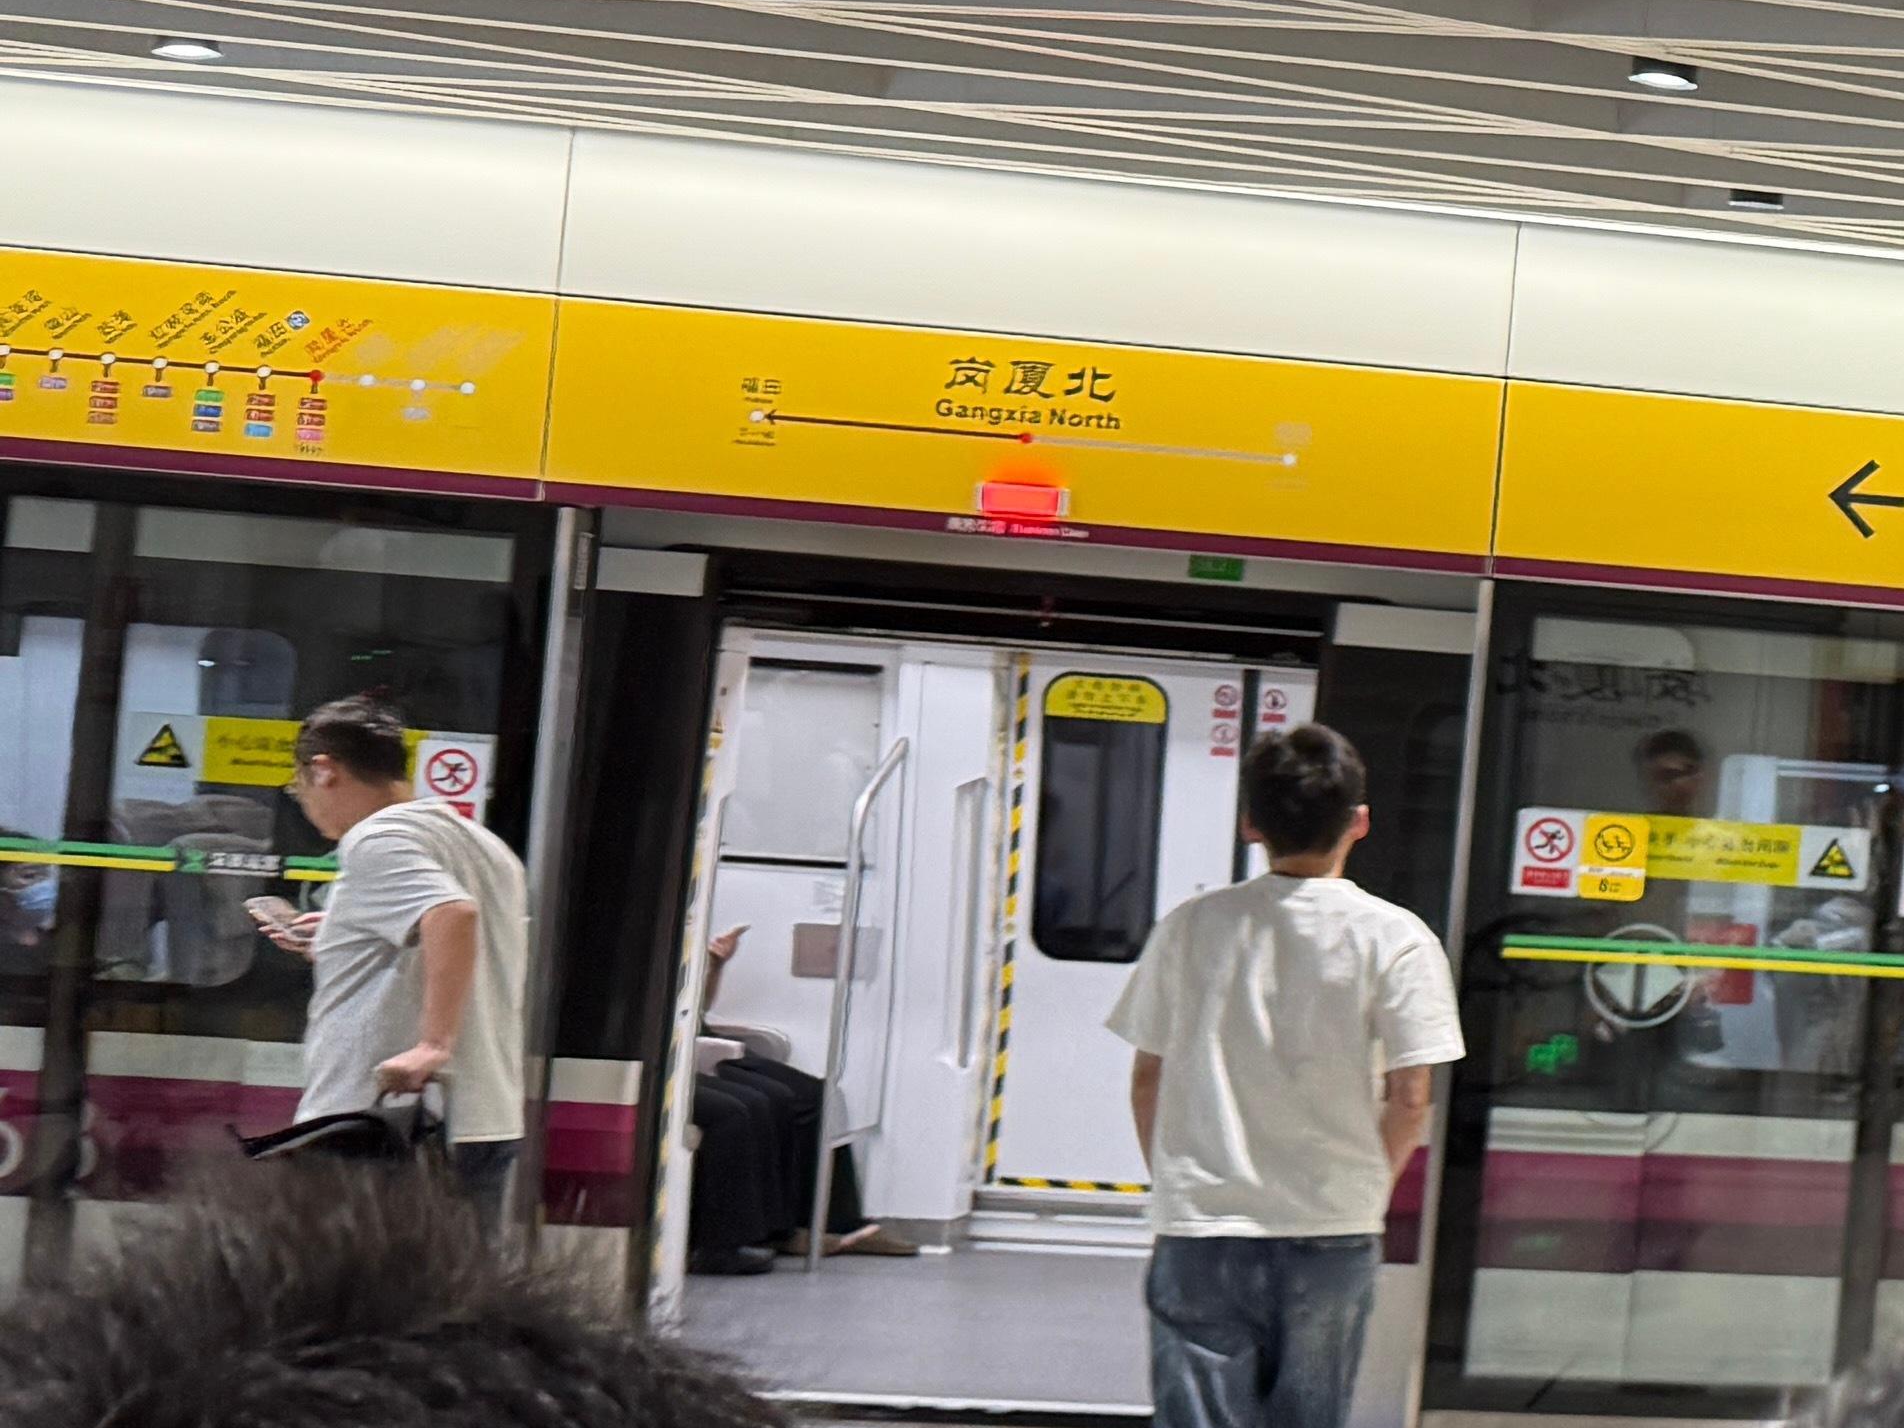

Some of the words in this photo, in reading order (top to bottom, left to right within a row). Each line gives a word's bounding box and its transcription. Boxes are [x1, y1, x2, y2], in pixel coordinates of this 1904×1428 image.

[944, 356, 1117, 403] 岗厦北
[935, 398, 1041, 426] Gangxia
[1048, 407, 1122, 430] North
